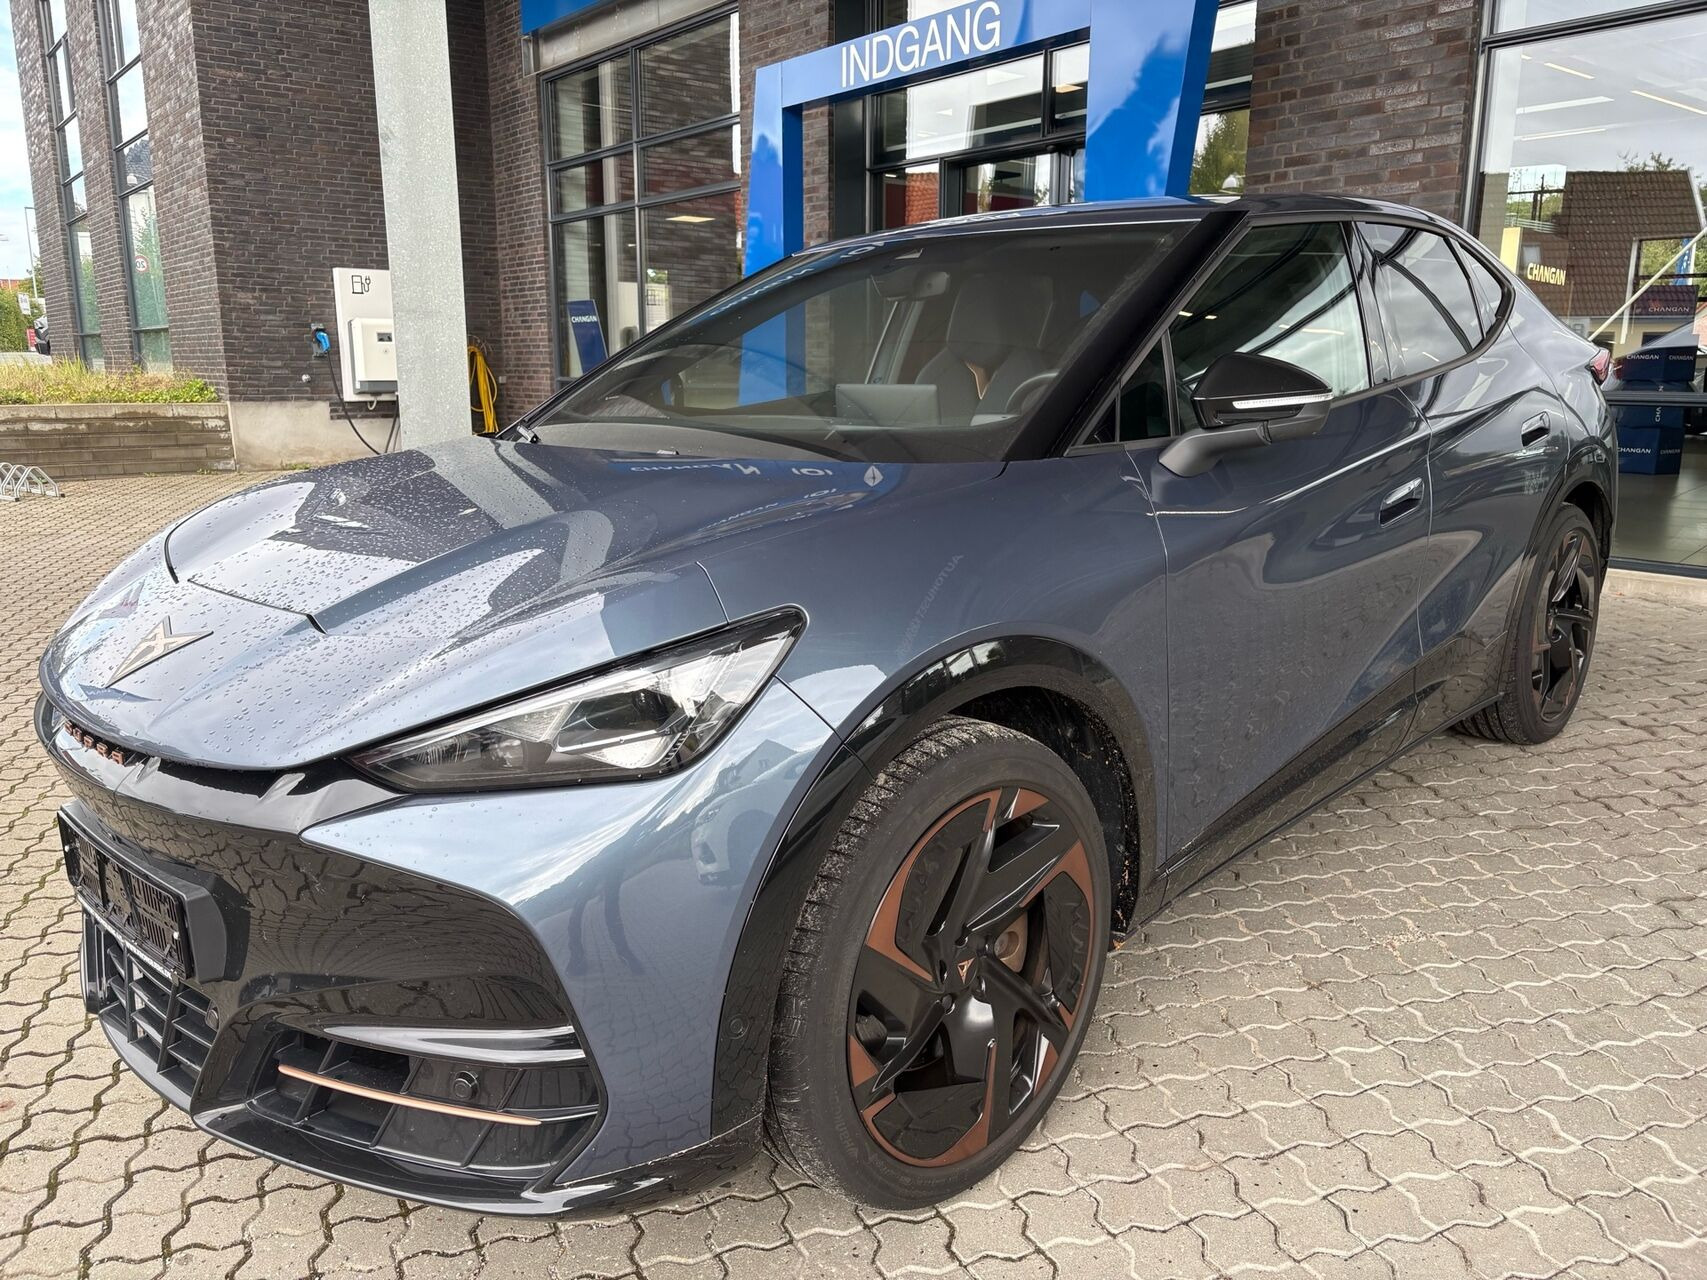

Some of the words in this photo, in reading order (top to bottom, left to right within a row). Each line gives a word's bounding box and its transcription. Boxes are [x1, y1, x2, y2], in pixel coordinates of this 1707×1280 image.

[841, 1, 1001, 88] INDGANG
[1527, 262, 1567, 287] CHANGAN
[571, 315, 598, 323] CHANGAN
